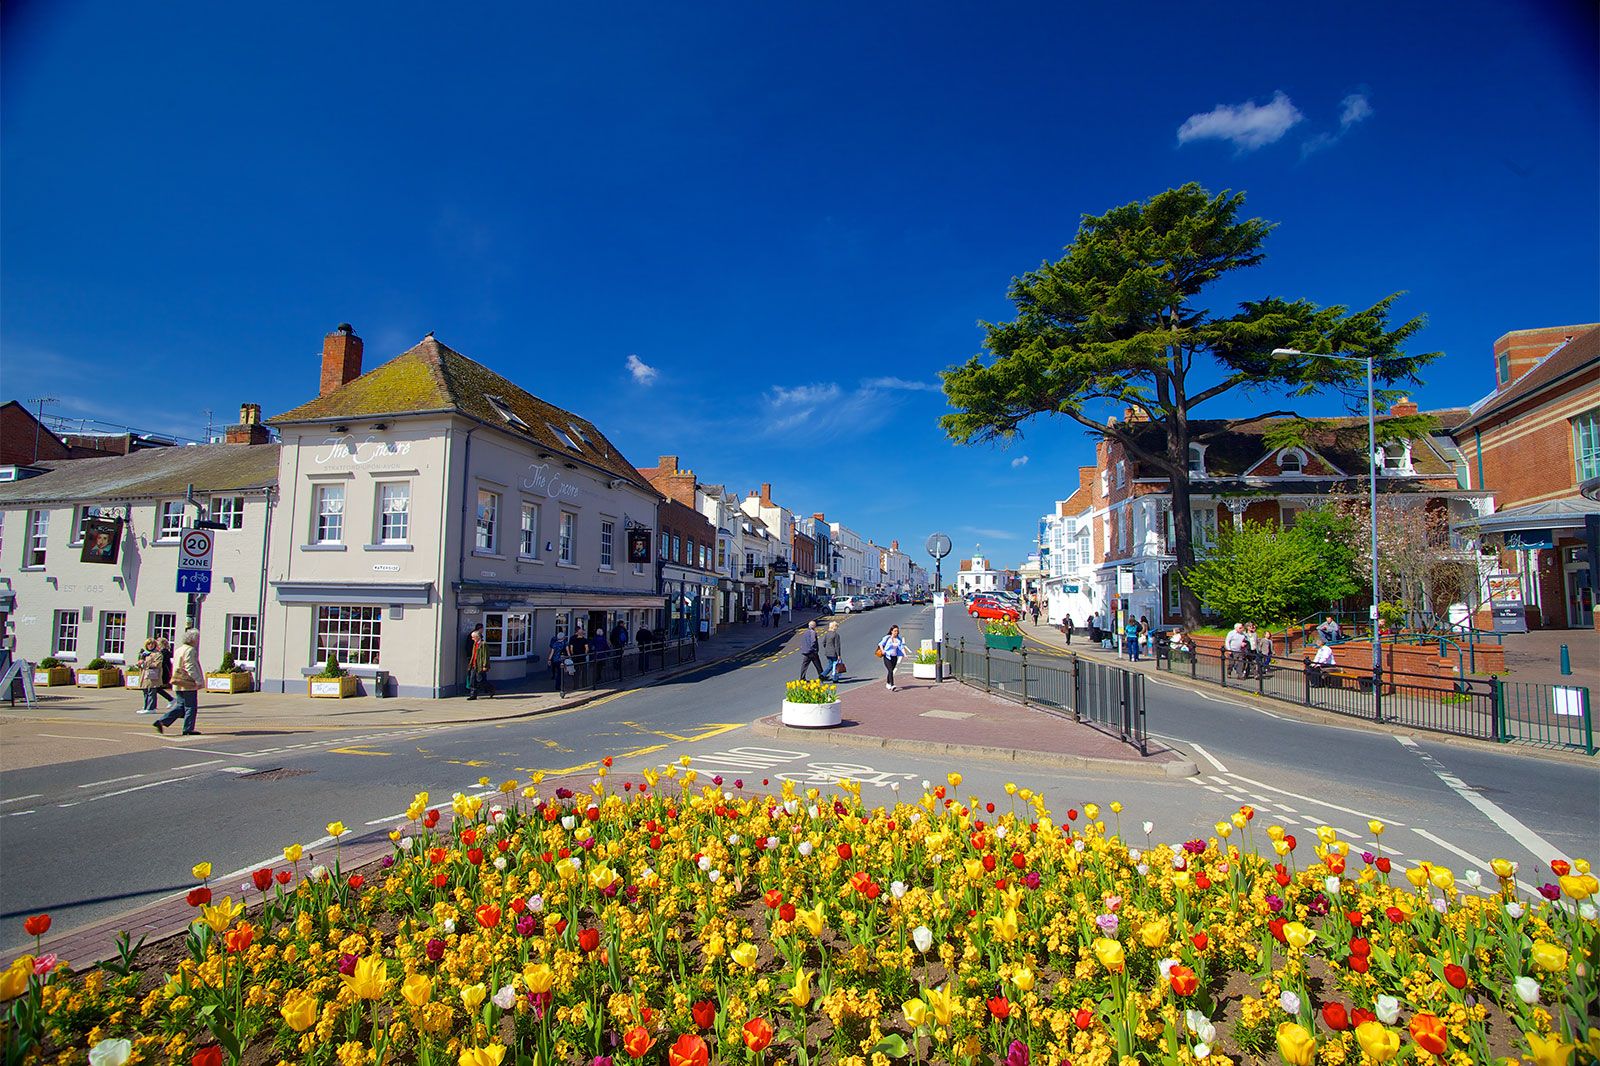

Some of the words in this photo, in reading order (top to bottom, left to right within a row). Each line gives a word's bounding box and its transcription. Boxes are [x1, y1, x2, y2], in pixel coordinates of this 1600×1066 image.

[315, 434, 352, 463] The
[353, 436, 411, 464] Encore
[523, 463, 549, 488] The
[547, 473, 579, 498] Encore
[187, 538, 207, 550] 20
[182, 558, 209, 567] ZONE
